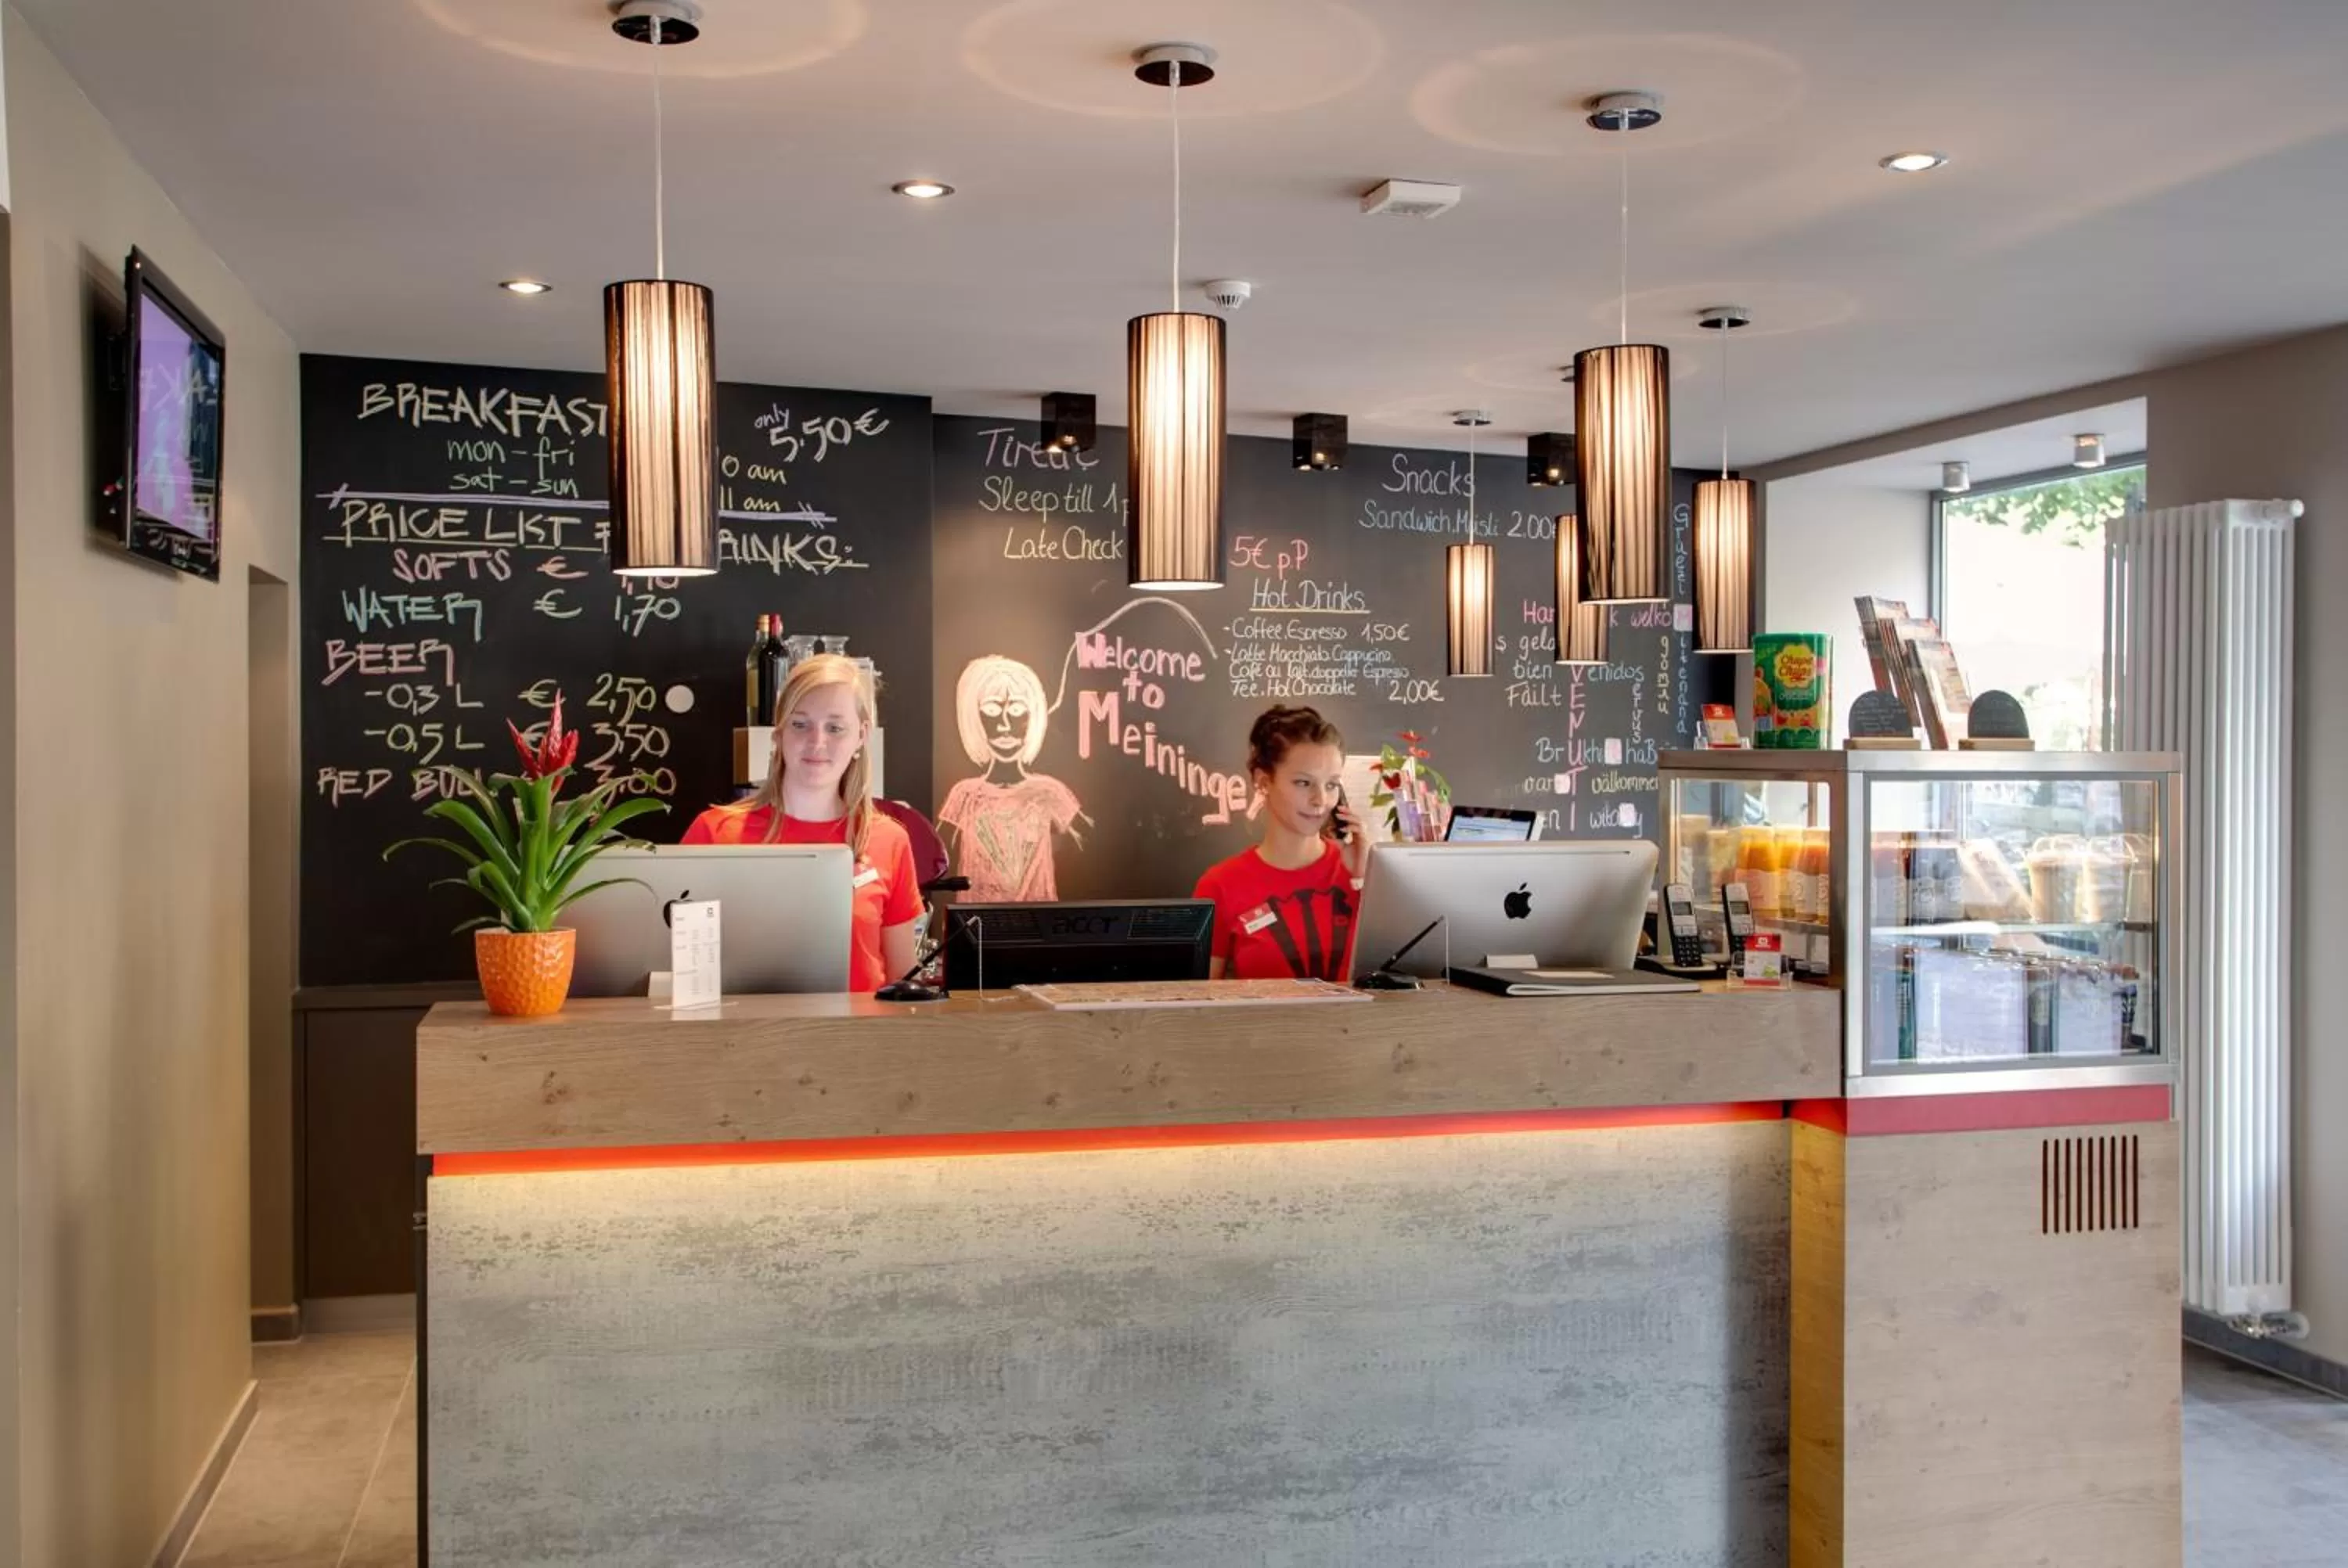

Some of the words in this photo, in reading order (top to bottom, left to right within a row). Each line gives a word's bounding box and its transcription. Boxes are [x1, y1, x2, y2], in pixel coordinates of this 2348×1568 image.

[357, 382, 608, 438] BREAKFAST
[754, 402, 790, 430] only
[447, 440, 506, 464] mon
[532, 436, 576, 482] fri
[747, 463, 787, 485] am
[1381, 453, 1475, 498] Snacks
[448, 466, 502, 493] sat
[530, 478, 579, 499] sun
[744, 496, 781, 512] am
[978, 475, 1059, 523] Sleep
[1064, 481, 1096, 514] till
[340, 499, 470, 548] PRICE
[484, 509, 582, 547] LIST
[1003, 527, 1058, 560] Late
[1061, 524, 1125, 560] Check
[392, 548, 513, 584] SOFTS
[341, 584, 484, 643] WATER
[614, 594, 682, 638] 1,70
[1251, 577, 1291, 610] Hot
[1295, 579, 1367, 612] Drinks
[321, 638, 456, 688] BEER
[1075, 631, 1207, 682] Welcome
[585, 672, 657, 728] 2,50
[1122, 670, 1165, 709] to
[583, 721, 671, 768] 3,50
[317, 766, 393, 810] RED
[1051, 915, 1120, 934] acer
